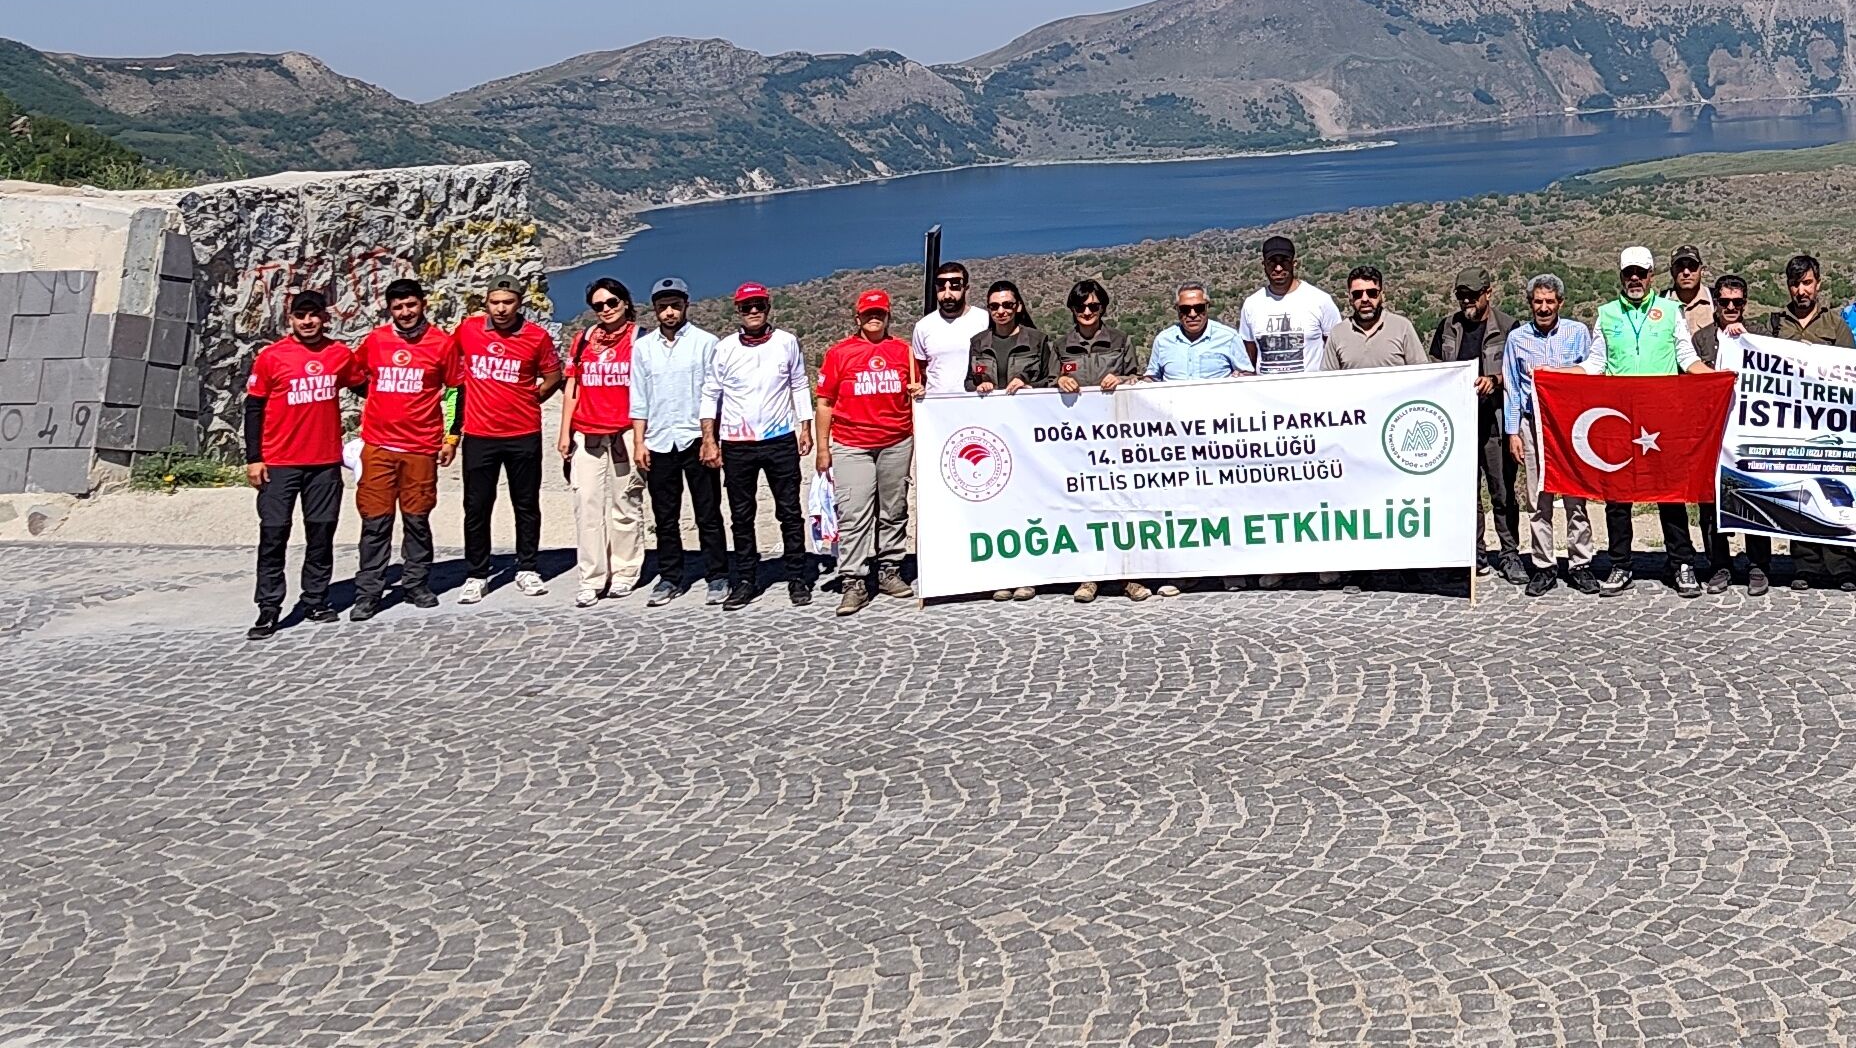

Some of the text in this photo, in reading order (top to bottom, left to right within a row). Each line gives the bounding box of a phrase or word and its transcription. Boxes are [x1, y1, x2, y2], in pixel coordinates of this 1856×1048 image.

[471, 354, 522, 372] TATVAN
[582, 361, 630, 375] TATVAN
[1742, 349, 1809, 379] KUZEY
[377, 366, 425, 382] TATVAN
[581, 373, 603, 387] RUN
[855, 368, 900, 383] TATVAN
[396, 380, 424, 393] CLUB
[854, 380, 902, 396] RUN CLUB
[1740, 373, 1792, 397] HIZLI
[1800, 381, 1854, 404] TREN
[287, 390, 313, 406] RUN
[1033, 409, 1368, 443] DOĞA KORUMA VE MİLLİ PARKLAR
[1088, 434, 1316, 466] 14. BÖLGE MÜDÜRLÜĞÜ
[1066, 458, 1344, 493] BİTLİS DKMP İL MÜDÜRLÜĞÜ
[969, 497, 1432, 563] DOĞA TURİZM ETKİNLİĞİ
